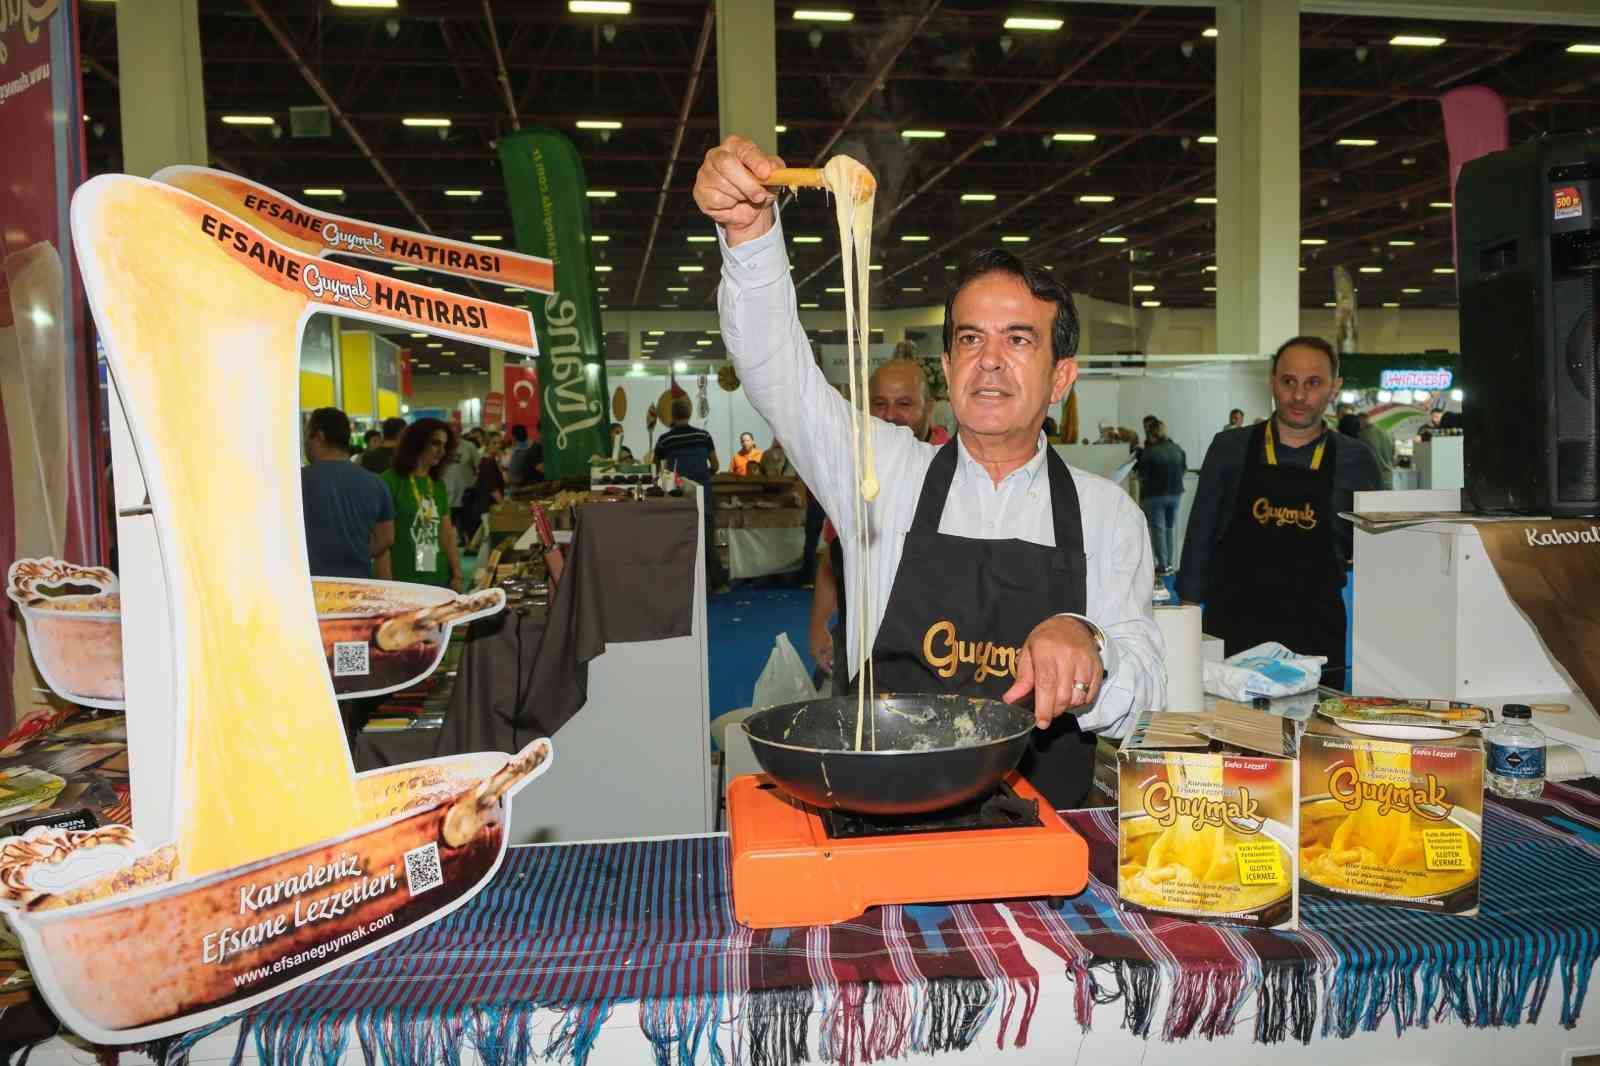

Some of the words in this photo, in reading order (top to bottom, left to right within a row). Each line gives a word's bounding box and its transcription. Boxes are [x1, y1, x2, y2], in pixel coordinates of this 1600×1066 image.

[243, 194, 322, 233] EFSANE
[322, 223, 385, 255] Guymak
[390, 237, 500, 272] HATIRASI
[201, 214, 300, 281] EFSANE
[302, 264, 371, 308] Guymak
[374, 282, 489, 328] HATIRASI
[1253, 497, 1318, 530] Guymak
[1524, 526, 1600, 546] Kahval
[923, 620, 1022, 683] Guym
[1143, 781, 1264, 835] Guymak
[1328, 766, 1454, 821] Guymak
[201, 914, 288, 964] Efsane
[294, 864, 398, 928] Lezzetleri
[239, 852, 363, 915] Karadeniz
[233, 912, 395, 988] www.efsaneguymak.com
